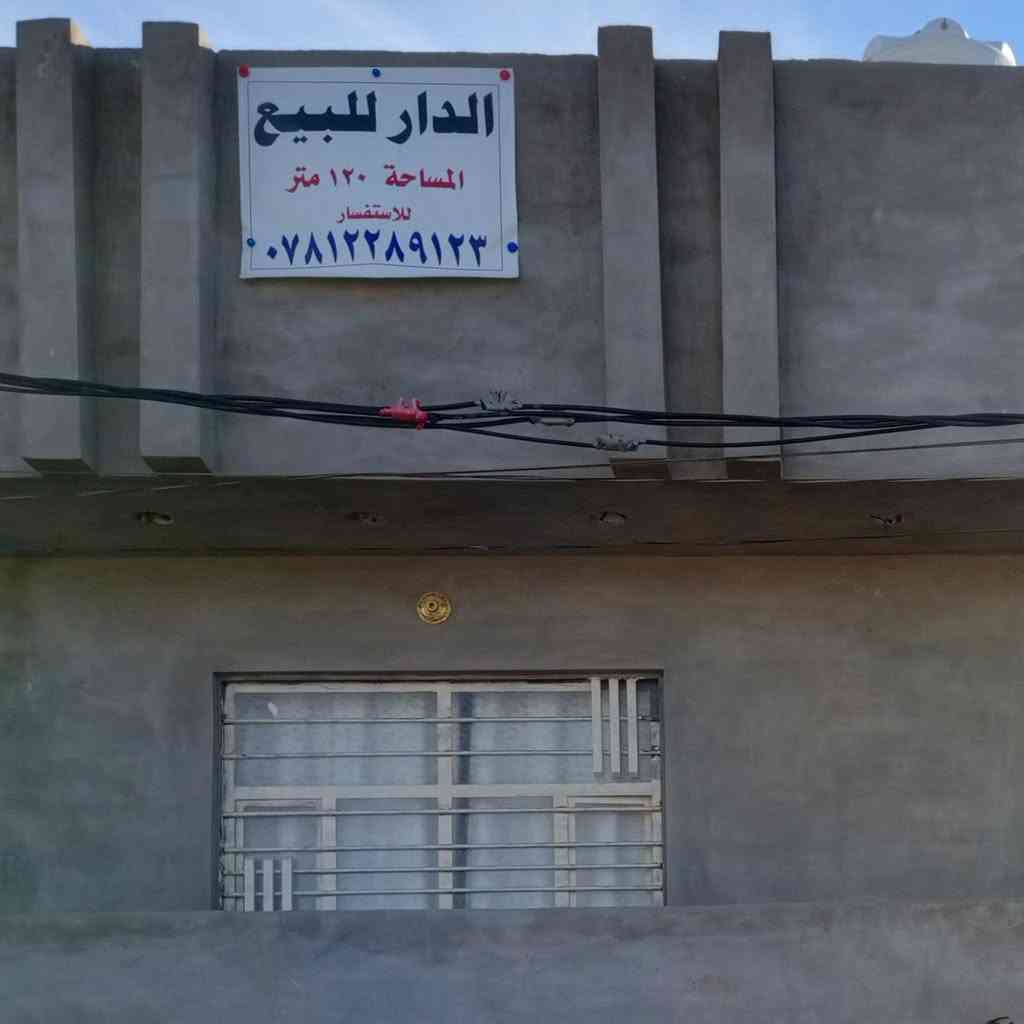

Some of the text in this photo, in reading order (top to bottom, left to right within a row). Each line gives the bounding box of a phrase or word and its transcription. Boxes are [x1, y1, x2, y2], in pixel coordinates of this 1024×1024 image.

[254, 89, 495, 146] الدار للبيع
[285, 163, 464, 192] المساحة ١٢٠ متر
[336, 203, 412, 223] للاستفسار
[266, 229, 487, 266] ٠٧٨١٢٢٨٩١٢٣
